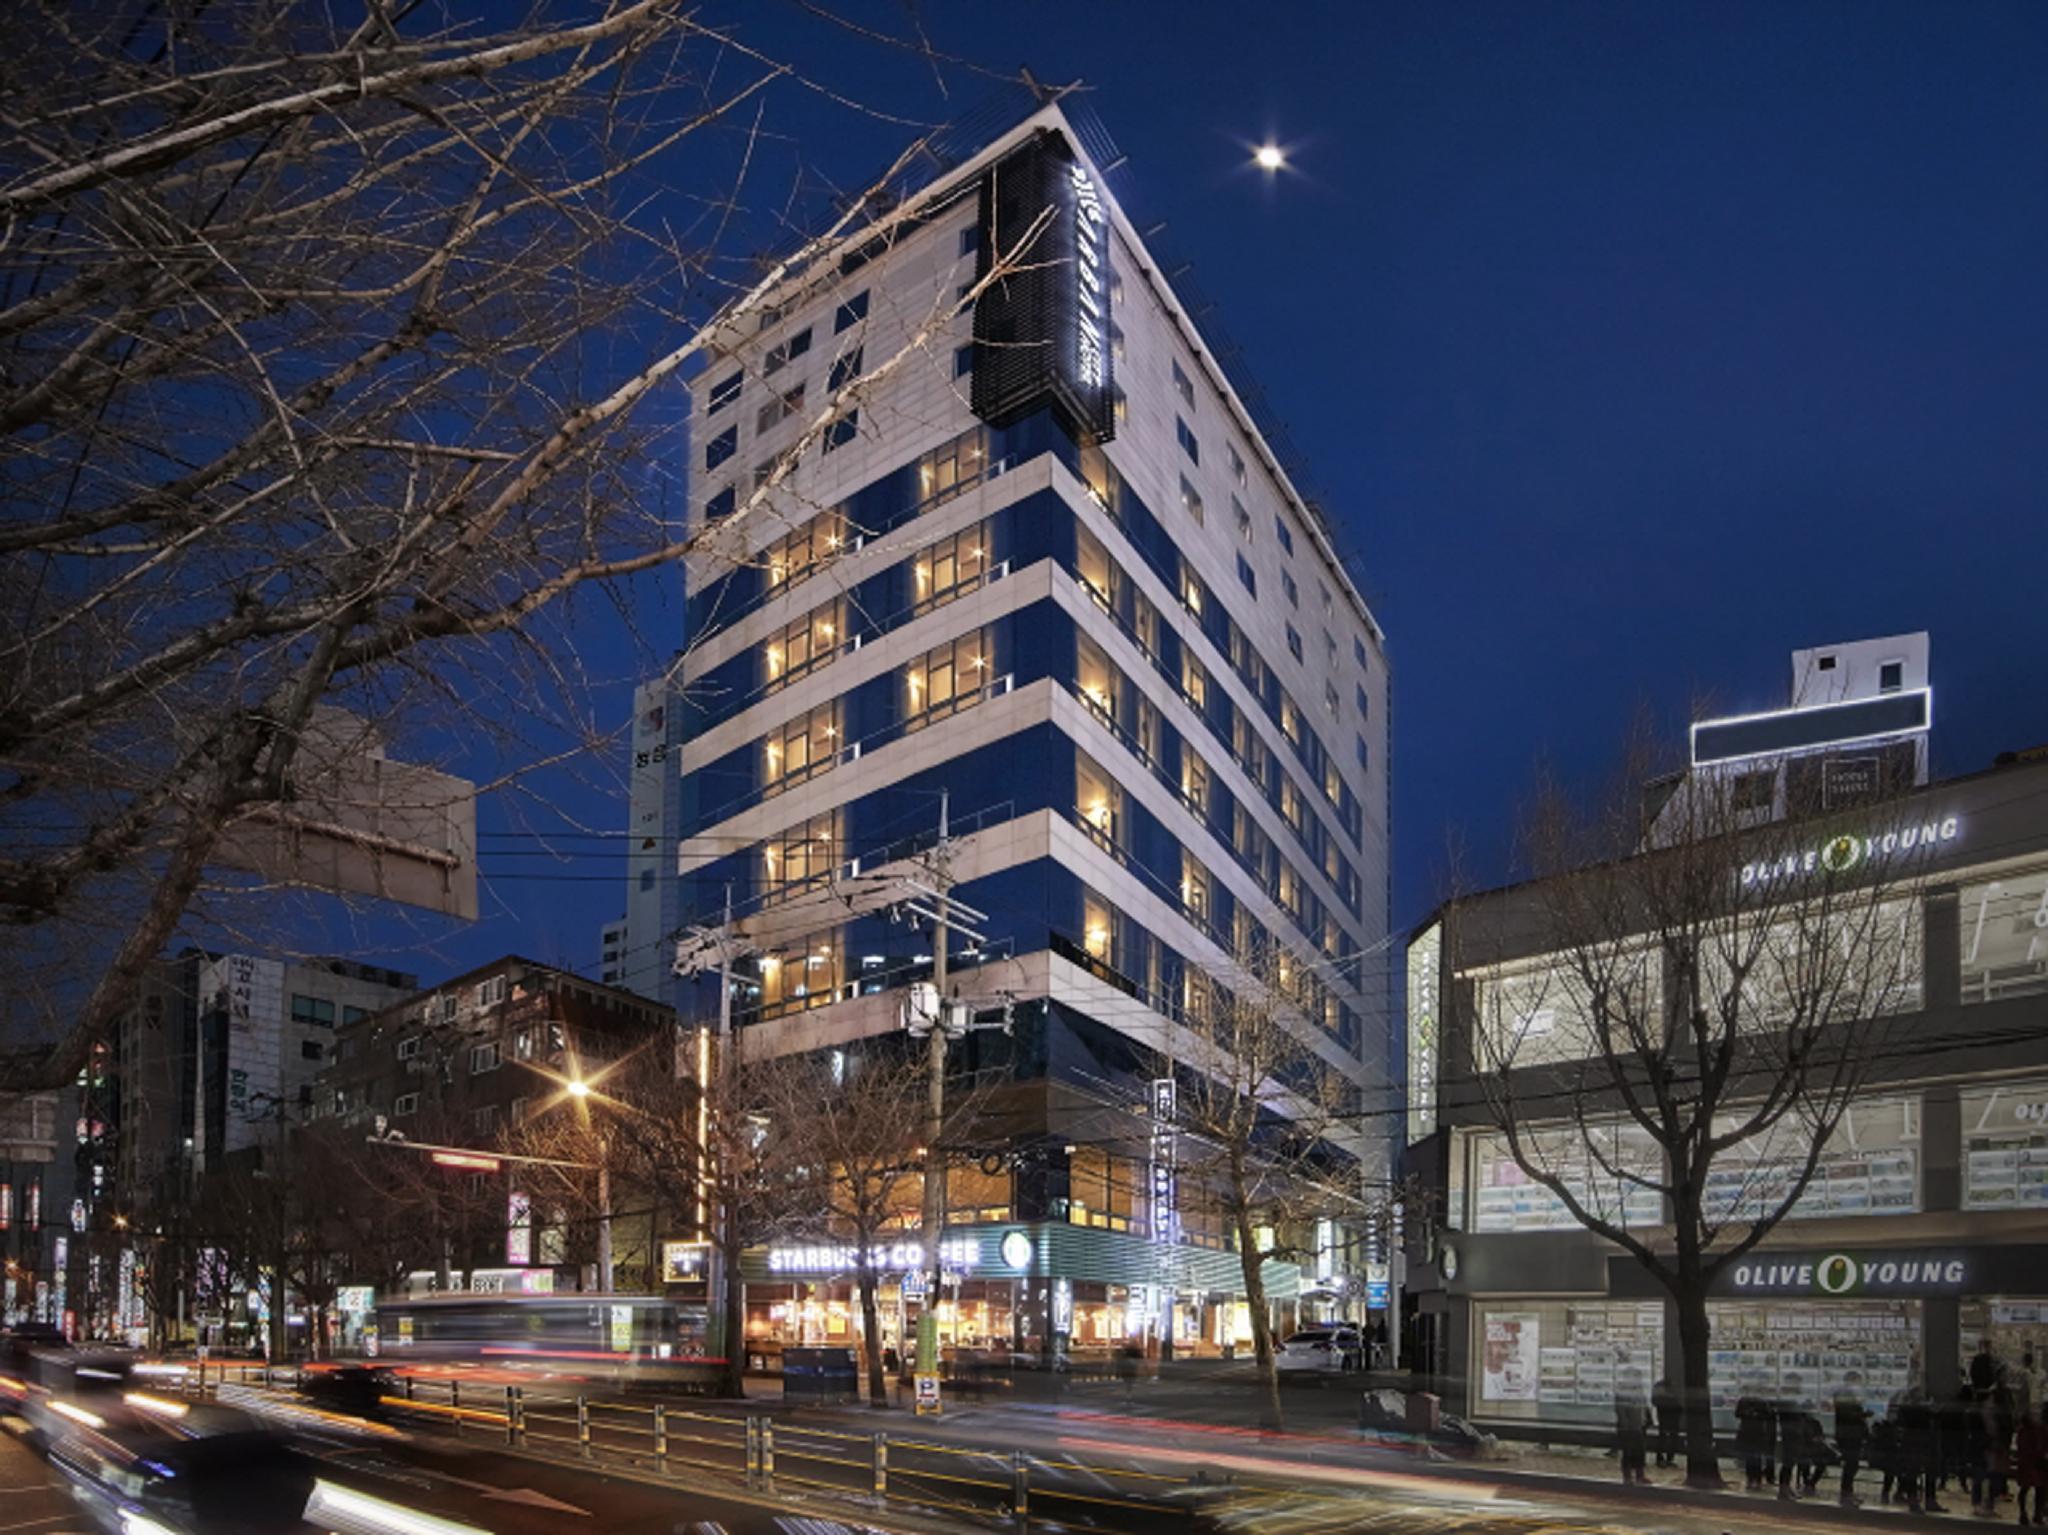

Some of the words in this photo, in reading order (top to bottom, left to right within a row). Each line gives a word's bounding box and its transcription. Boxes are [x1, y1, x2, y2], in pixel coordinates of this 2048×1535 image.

[1741, 851, 1817, 884] OLIVE
[1866, 817, 1959, 858] YOUNG
[768, 1244, 887, 1271] STARBUCS
[891, 1239, 981, 1267] COFEE
[1734, 1265, 1812, 1286] OLIVE
[1863, 1260, 1964, 1284] YOUNG
